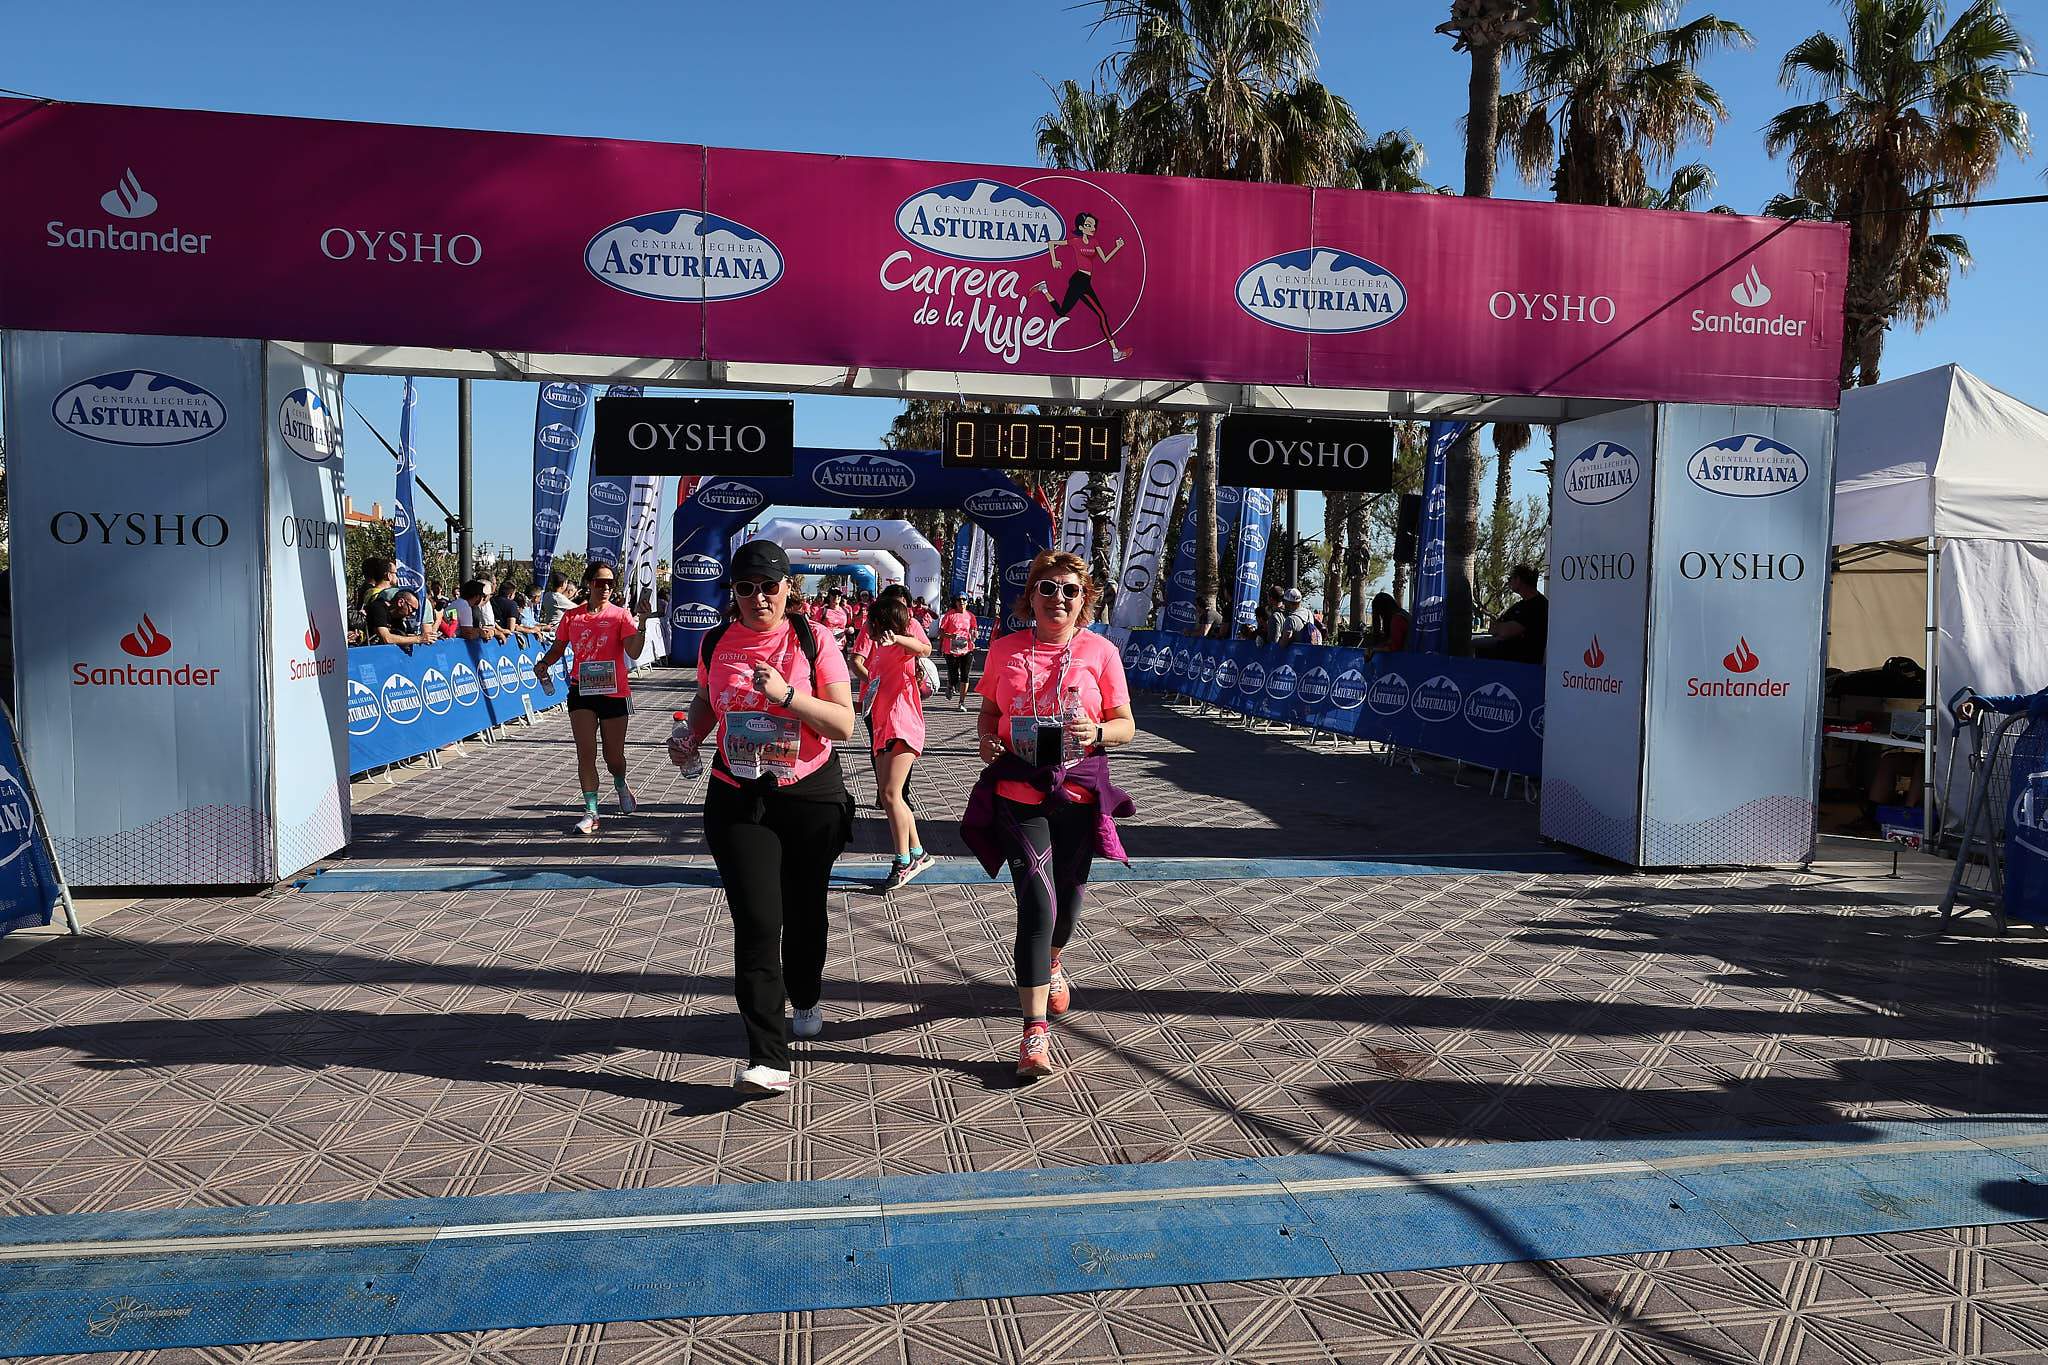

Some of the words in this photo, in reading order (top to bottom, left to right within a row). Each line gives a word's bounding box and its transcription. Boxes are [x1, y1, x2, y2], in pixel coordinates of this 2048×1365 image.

[909, 205, 1050, 243] ASTURIANA
[935, 205, 989, 216] CENTRAL
[994, 208, 1048, 220] LECHERA
[46, 221, 212, 254] Santander
[320, 227, 483, 265] OYSHO
[631, 239, 694, 250] CENTRAL
[700, 241, 763, 254] LECHERA
[600, 240, 769, 280] ASTURIANA
[879, 250, 1020, 299] Carrera
[1276, 274, 1329, 286] CENTRAL
[1335, 278, 1389, 289] LECHERA
[1249, 276, 1394, 313] ASTURIANA
[1488, 291, 1616, 324] OYSHO
[913, 296, 940, 326] de
[945, 297, 964, 327] la
[959, 296, 1071, 364] Mujer
[1691, 309, 1808, 337] Santander
[66, 396, 215, 429] ASTURIANA
[92, 395, 149, 405] CENTRAL
[153, 397, 209, 407] LECHERA
[283, 407, 335, 450] ASTURIANA
[628, 422, 766, 453] OYSHO
[1248, 438, 1370, 471] OYSHO
[1579, 463, 1602, 473] CENTRAL
[1604, 458, 1632, 469] LECHERA
[1714, 455, 1752, 463] CENTRAL
[1756, 456, 1796, 464] LECHERA
[820, 468, 908, 488] ASTURIANA
[1568, 468, 1633, 493] ASTURIANA
[1695, 456, 1799, 483] ASTURIANA
[702, 492, 758, 505] ASTURIANA
[969, 499, 1024, 511] ASTURIANA
[50, 511, 229, 547] OYSHO
[282, 515, 338, 550] OYSHO
[800, 524, 881, 542] OYSHO
[1123, 459, 1178, 593] OYSHO
[675, 564, 720, 576] ASTURIANA
[1561, 552, 1635, 581] OYSHO
[1680, 552, 1804, 581] OYSHO
[674, 612, 719, 624] ASTURIANA
[72, 662, 221, 686] Santander
[289, 655, 336, 681] Santander
[1562, 671, 1623, 694] Santander
[1687, 678, 1790, 697] Santander
[385, 694, 421, 714] ASTURIANA
[1370, 687, 1405, 706] ASTURIANA
[1414, 690, 1457, 713] ASTURIANA
[1467, 699, 1515, 723] ASTURIANA
